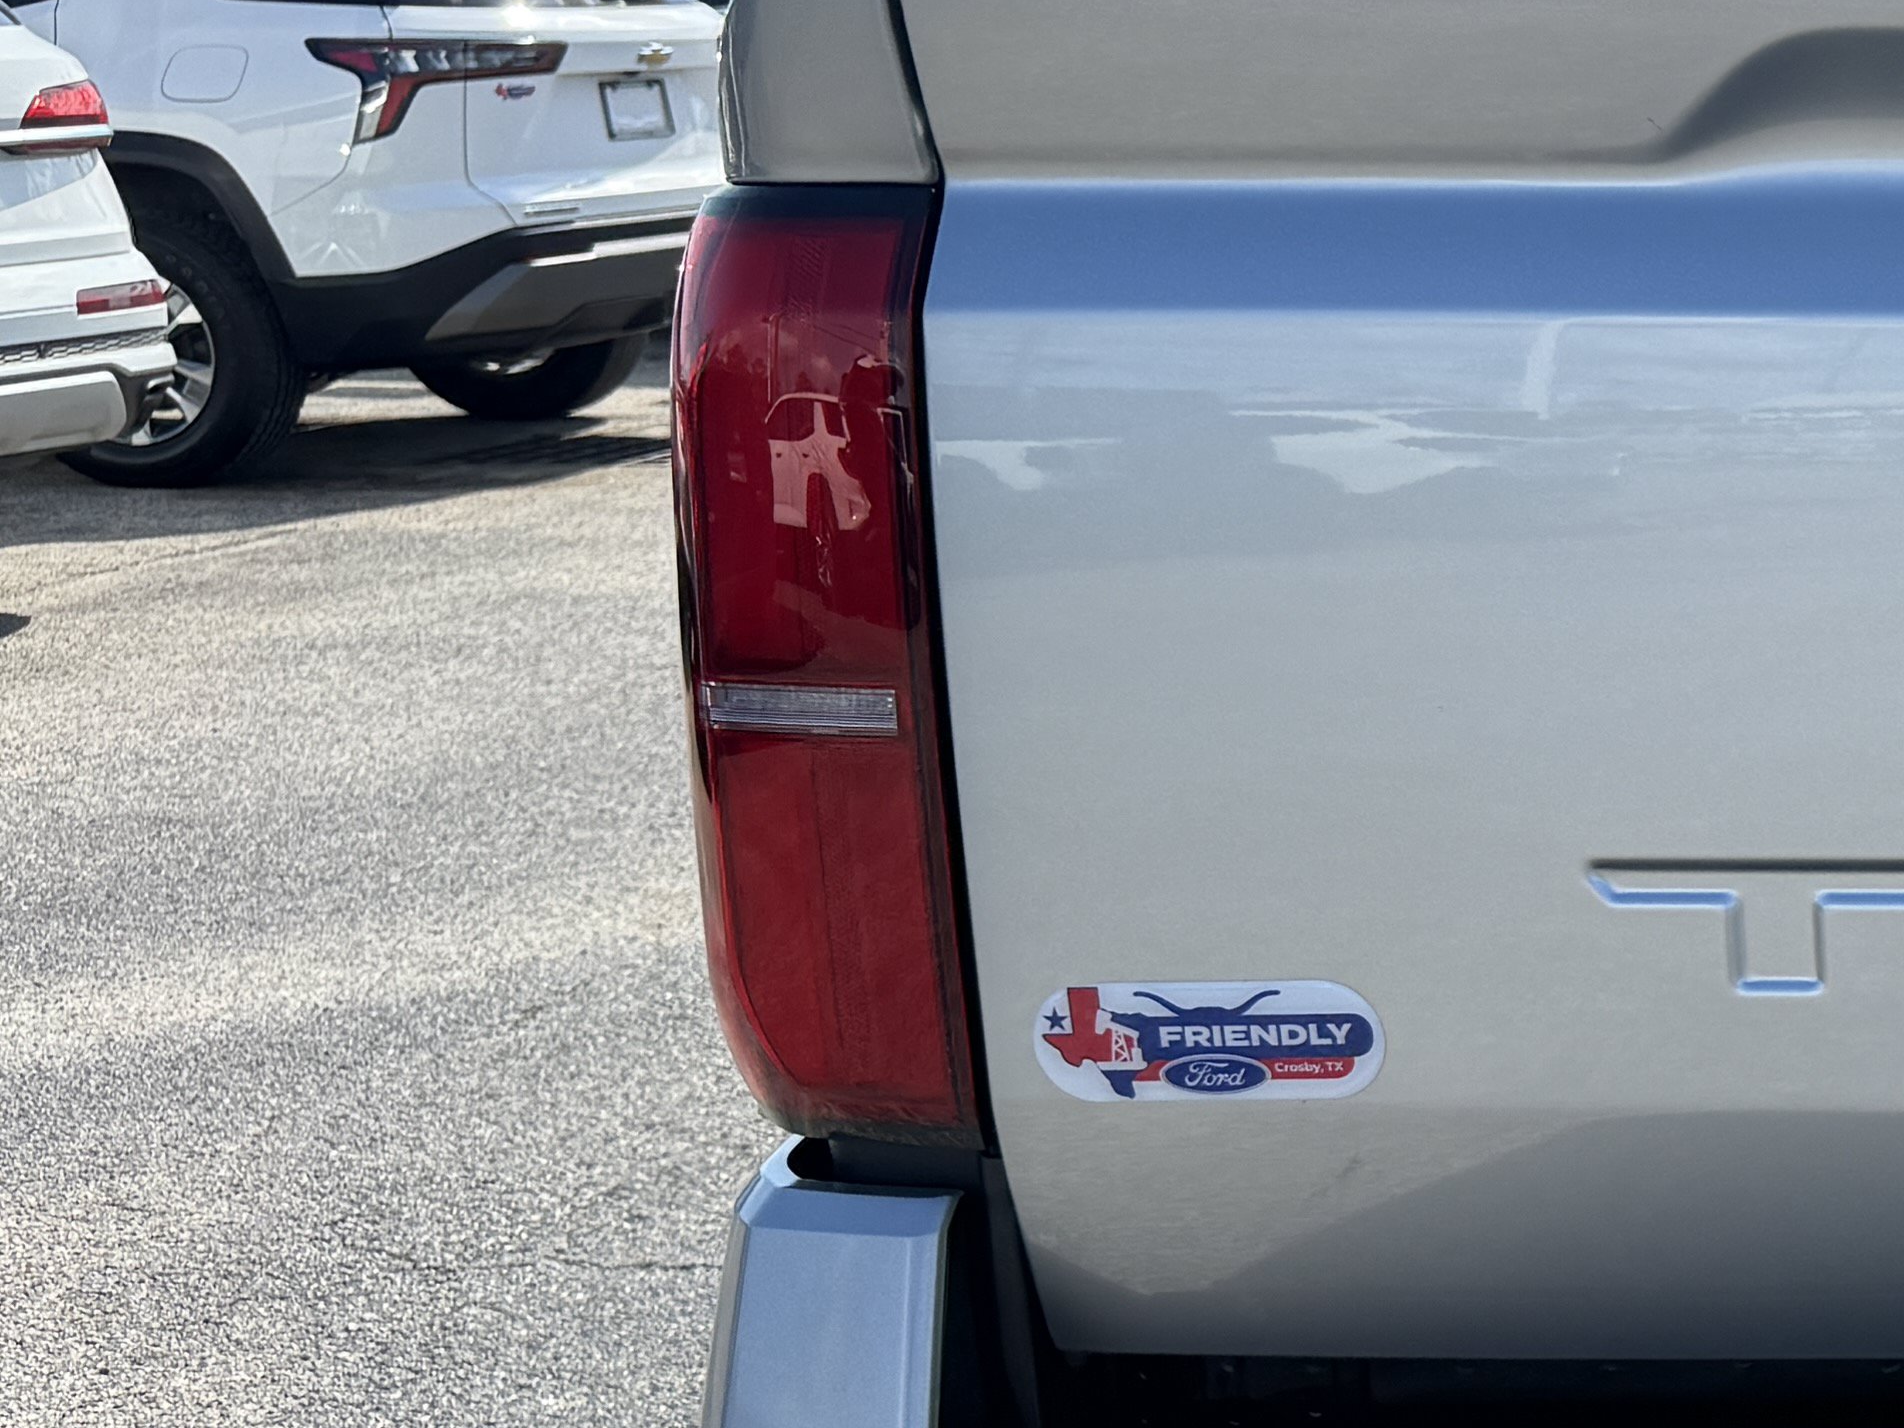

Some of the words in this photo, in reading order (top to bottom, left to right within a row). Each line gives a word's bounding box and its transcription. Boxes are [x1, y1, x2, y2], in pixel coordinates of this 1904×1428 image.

[1158, 1023, 1353, 1049] FRIENDLY
[1184, 1061, 1246, 1088] Ford
[1274, 1061, 1323, 1075] Crosby,
[1325, 1061, 1344, 1073] TX
